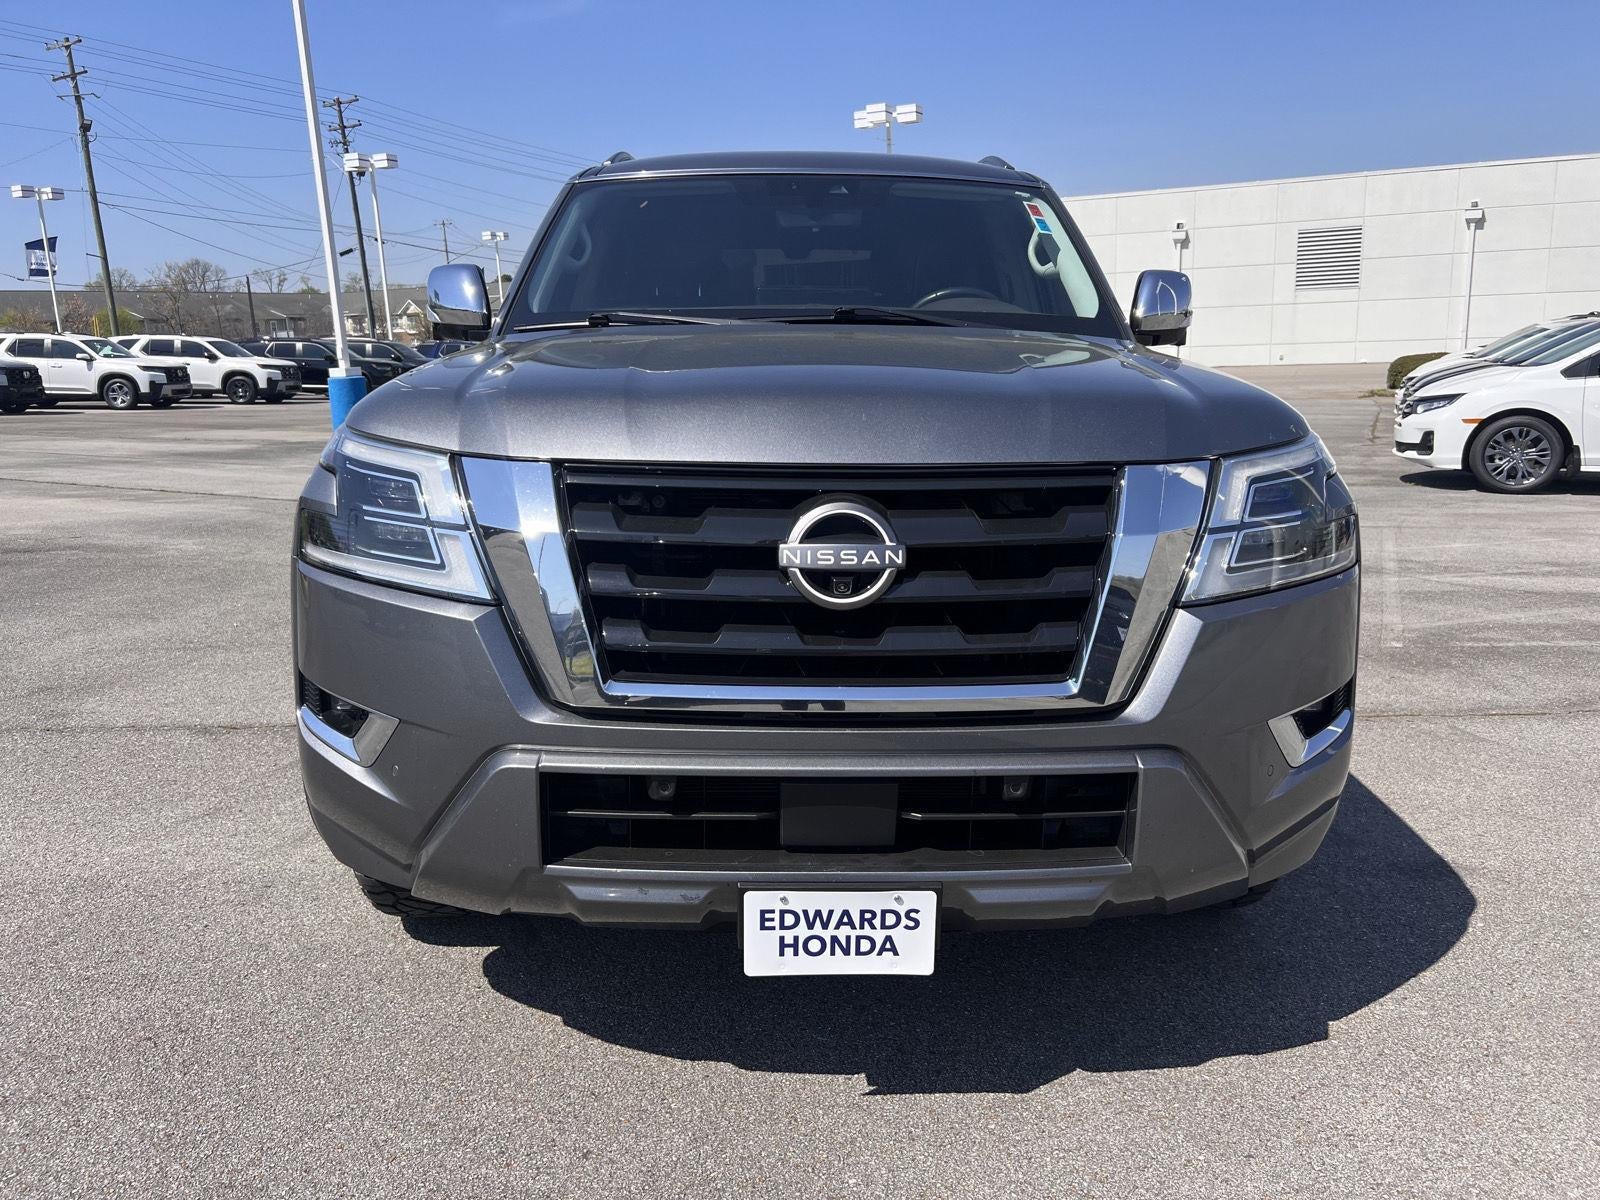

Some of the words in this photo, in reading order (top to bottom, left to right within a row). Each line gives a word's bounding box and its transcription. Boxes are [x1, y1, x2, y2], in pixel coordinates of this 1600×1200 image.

[782, 549, 903, 565] NISSAN
[759, 908, 921, 931] EDWARDS
[778, 934, 900, 957] HONDA
